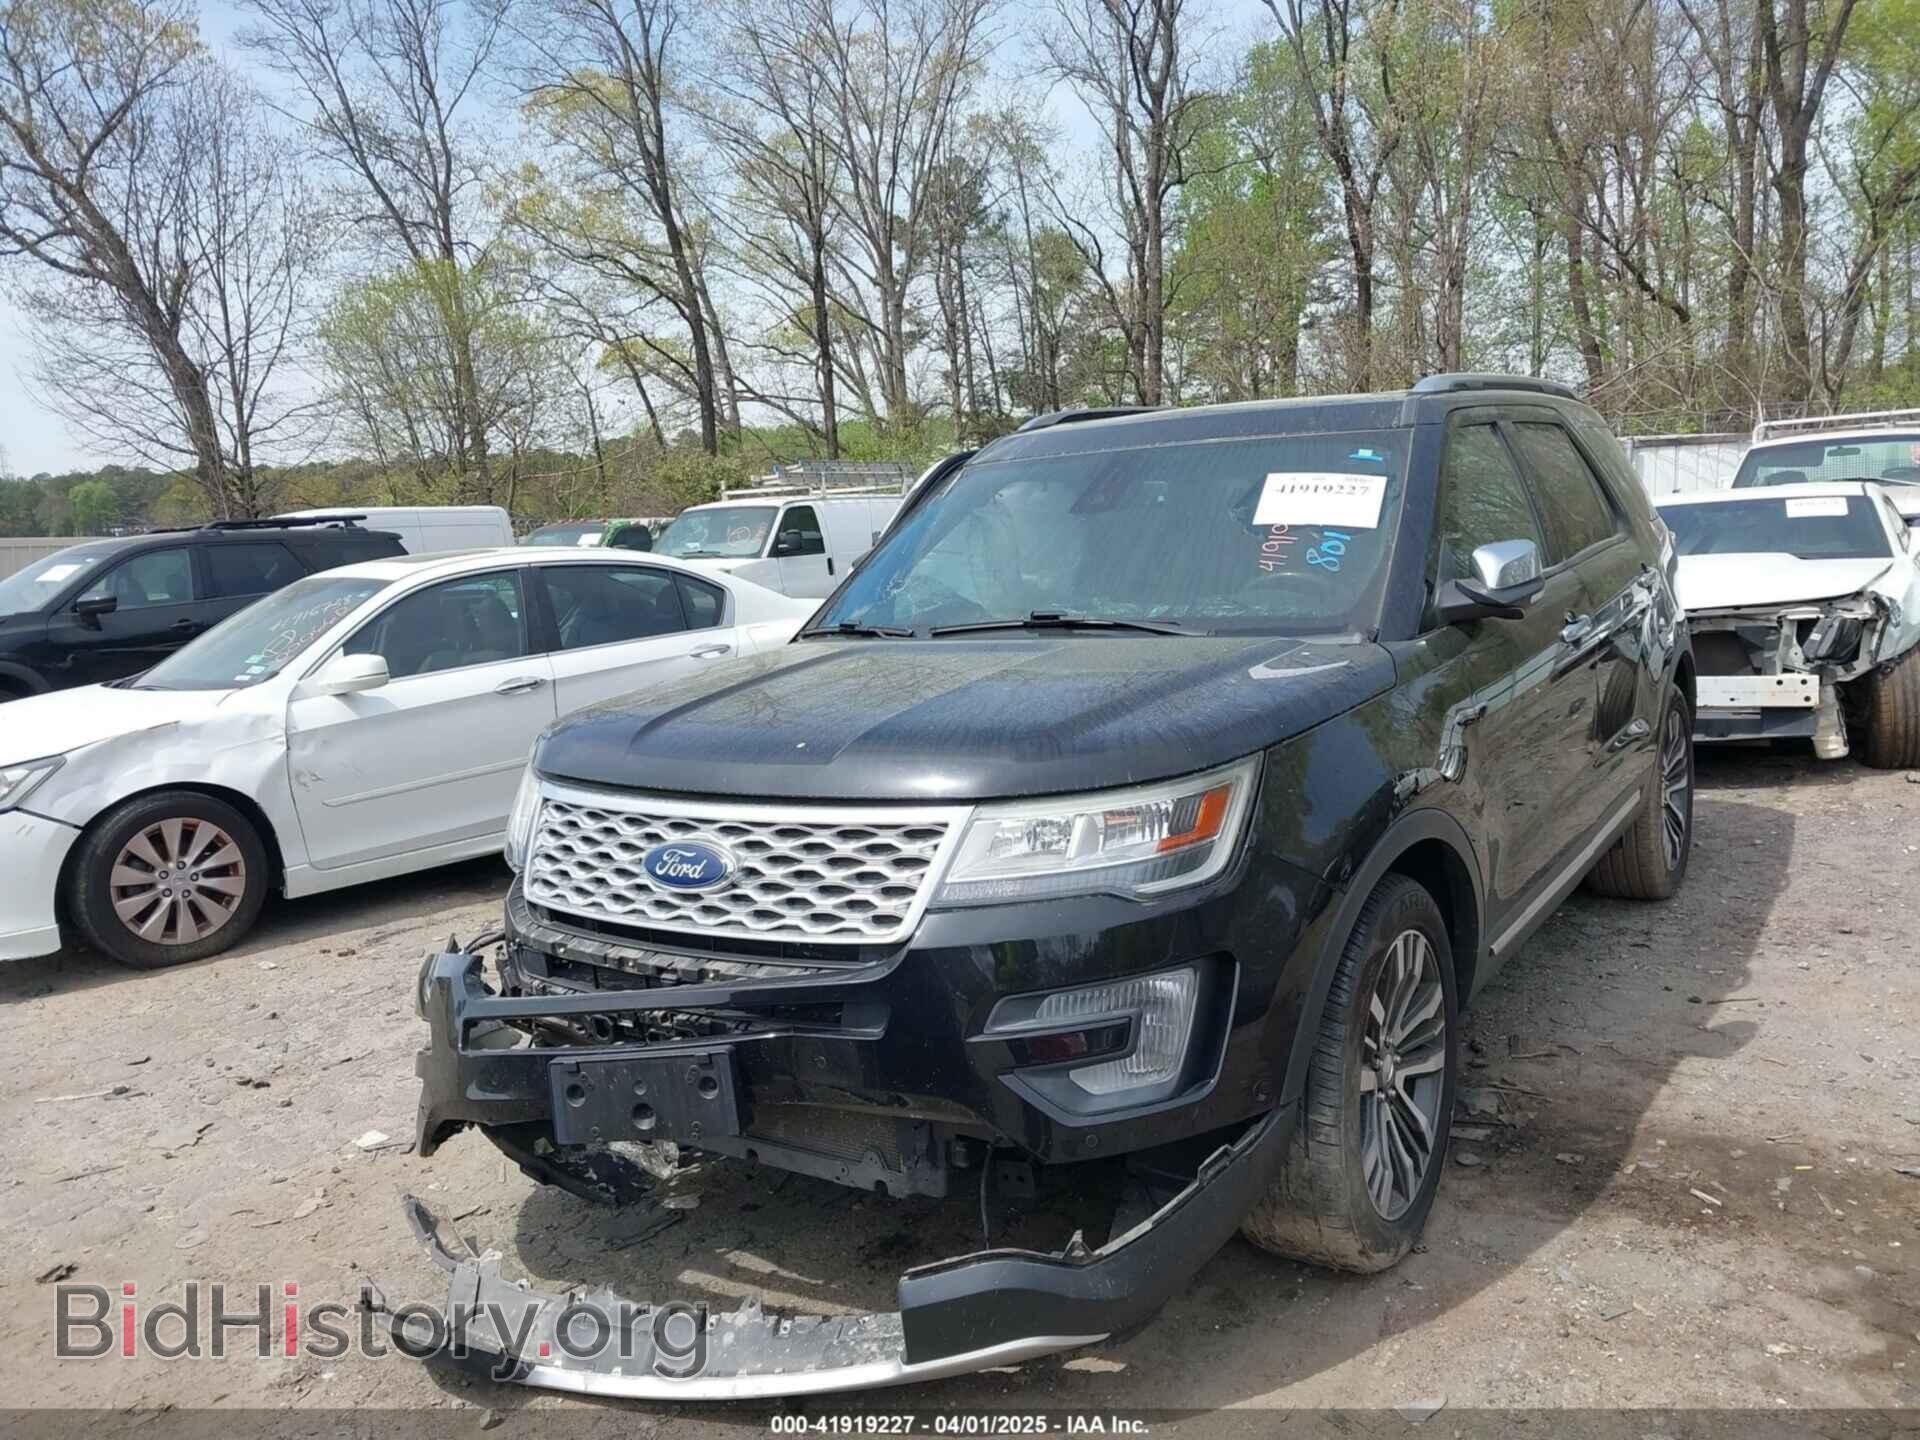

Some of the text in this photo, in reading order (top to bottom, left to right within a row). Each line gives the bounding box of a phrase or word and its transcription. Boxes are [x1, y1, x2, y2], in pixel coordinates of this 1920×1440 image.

[1274, 483, 1370, 495] 41919227
[1306, 531, 1351, 572] 801
[655, 848, 708, 879] Ford
